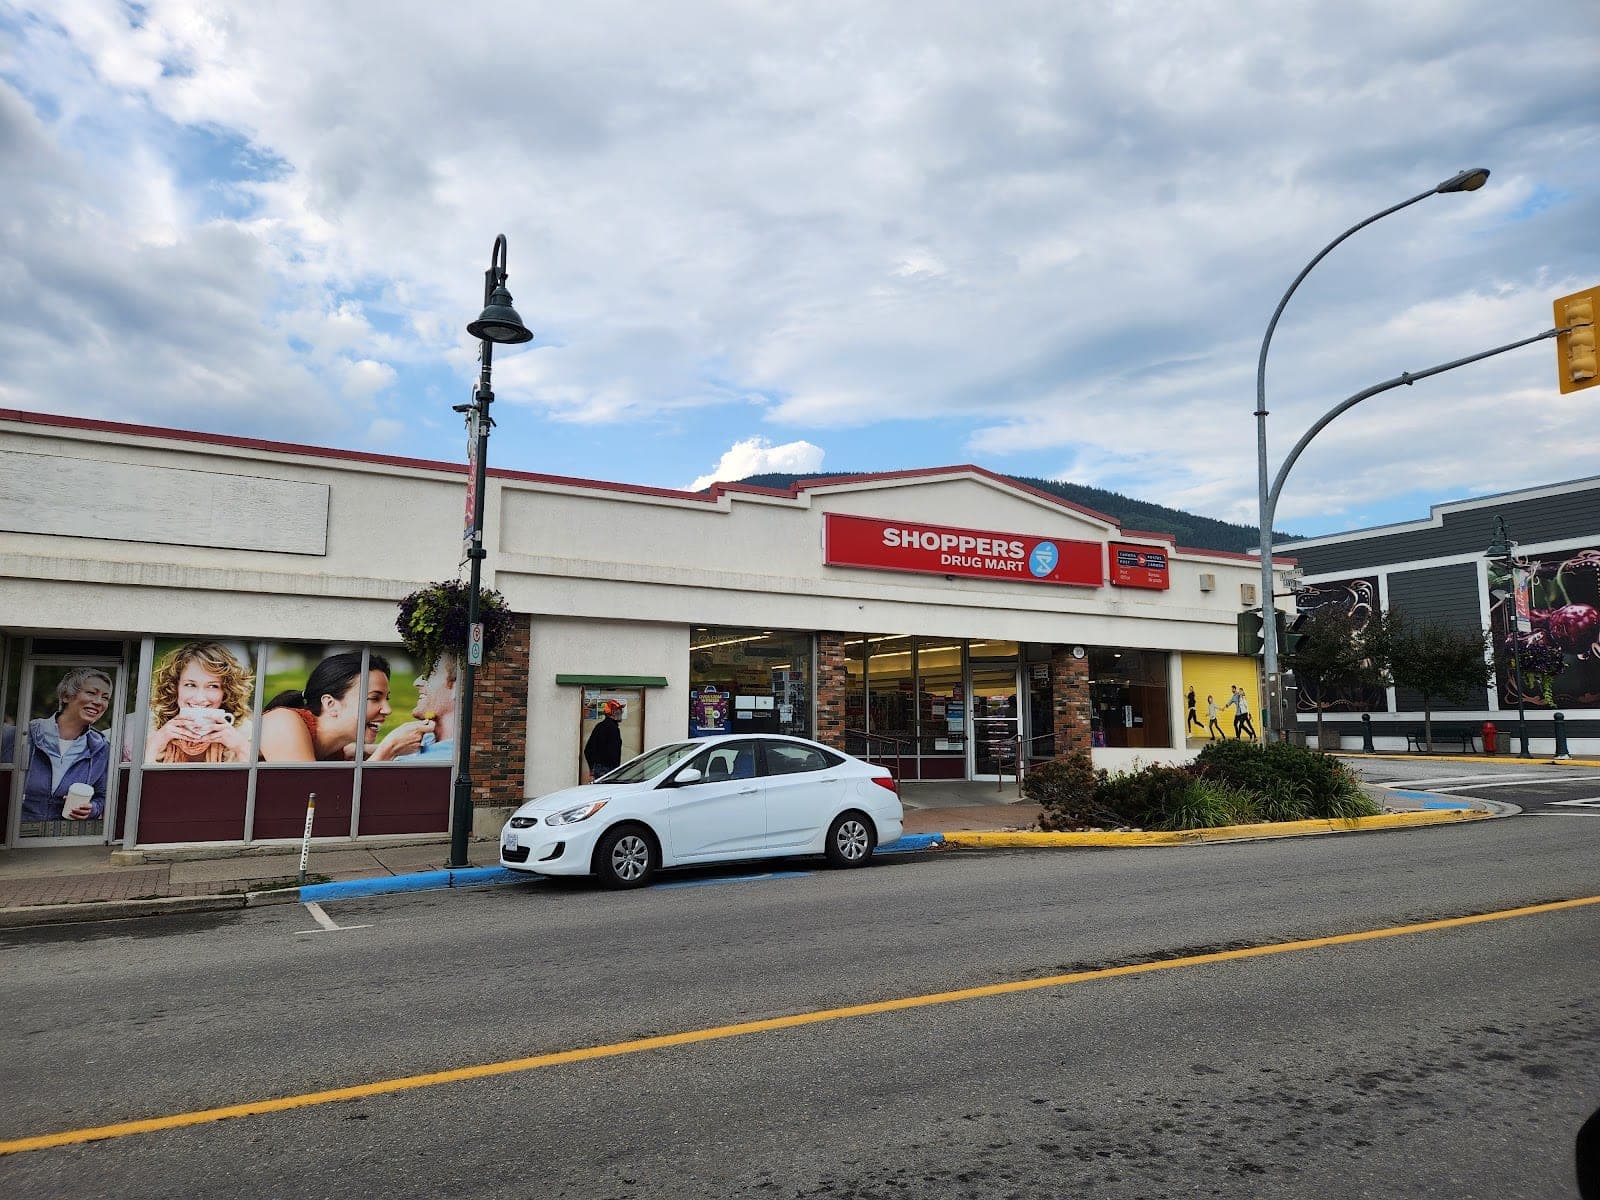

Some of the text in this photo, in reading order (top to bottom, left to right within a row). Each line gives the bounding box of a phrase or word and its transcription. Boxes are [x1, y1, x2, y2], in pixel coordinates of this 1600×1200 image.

[882, 527, 1025, 559] SHOPPERS
[941, 554, 1025, 572] DRUG MART
